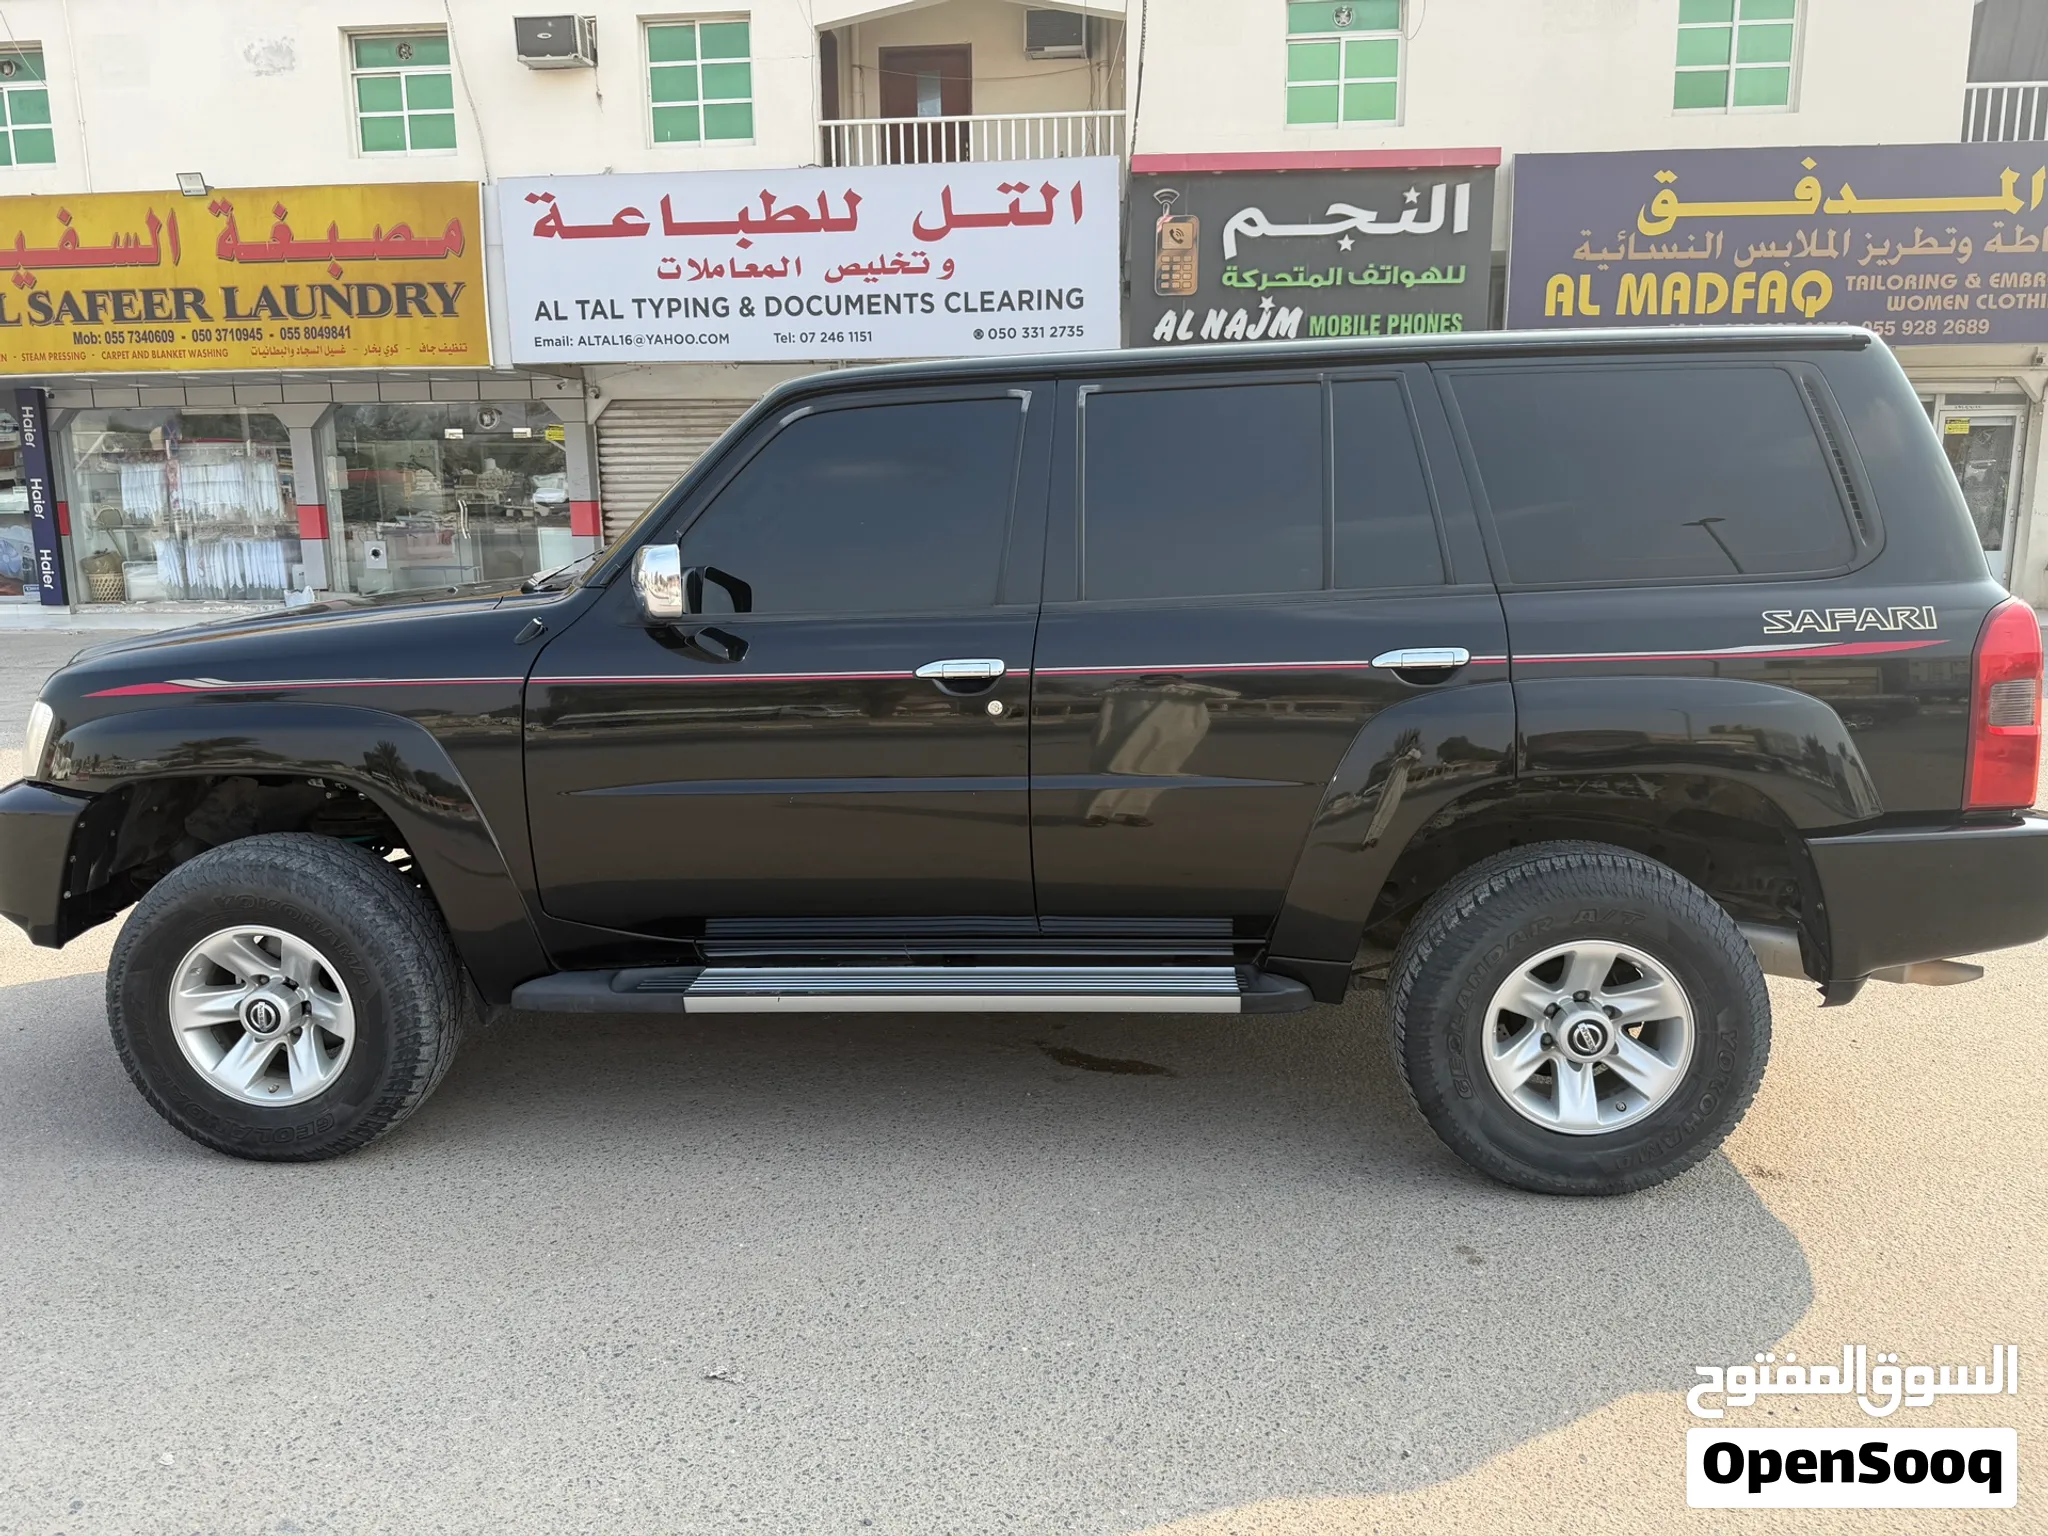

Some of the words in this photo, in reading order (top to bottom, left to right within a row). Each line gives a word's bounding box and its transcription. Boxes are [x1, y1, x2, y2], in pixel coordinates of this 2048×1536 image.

[1637, 156, 2046, 236] المدفق
[525, 187, 863, 250] للطباعة
[912, 180, 1084, 242] التل
[1222, 182, 1471, 260] النجم
[0, 207, 181, 289] السفي
[208, 198, 465, 279] مصبغة
[1573, 229, 1724, 271] النسائية
[1734, 227, 1851, 268] الملابس
[1857, 227, 1973, 267] وتطريز
[1984, 220, 2048, 253] اطة
[657, 256, 801, 281] المعاملات
[1221, 264, 1342, 291] المتحركة
[1348, 263, 1466, 285] للهواتف
[1845, 273, 1958, 292] TAILORING
[1965, 273, 1981, 288] &
[1989, 272, 2048, 288] EMBR
[28, 287, 214, 326] SAFEER
[221, 282, 466, 321] LAUNDRY
[535, 299, 569, 321] AL
[576, 298, 624, 320] TAL
[632, 296, 730, 319] TYPING
[739, 295, 756, 317] &
[765, 291, 935, 317] DOCUMENTS
[944, 287, 1085, 313] CLEARING
[1544, 274, 1600, 317] AL
[1615, 269, 1833, 319] MADFAQ
[1887, 294, 1968, 311] WOMEN
[1976, 293, 2048, 309] CLOTHI
[988, 327, 1017, 340] 050
[1021, 326, 1045, 339] 331
[1050, 325, 1084, 338] 2735
[1153, 309, 1194, 342] AL
[1200, 297, 1304, 341] NAJM
[1309, 314, 1381, 337] MOBILE
[1387, 313, 1463, 334] PHONES
[1862, 321, 1895, 336] 055
[1902, 320, 1937, 336] 928
[1943, 319, 1990, 335] 2689
[73, 331, 101, 345] Mob:
[105, 331, 125, 344] 055
[128, 330, 174, 343] 7340609
[192, 329, 212, 342] 050
[215, 328, 263, 342] 3710945
[280, 327, 300, 340] 055
[304, 326, 351, 339] 8049841
[419, 343, 437, 353] جاف
[438, 343, 468, 353] تنظيف
[534, 335, 574, 348] Email:
[577, 333, 730, 347] ALTAL16@YAHOO.COM
[774, 332, 795, 344] Tel:
[799, 332, 816, 344] 07
[820, 331, 845, 343] 246
[848, 331, 873, 343] 1151
[21, 352, 47, 362] STEAM
[48, 351, 87, 361] PRESSING
[101, 350, 130, 360] CARPET
[132, 350, 150, 359] AND
[151, 349, 186, 359] BLANKET
[188, 348, 228, 359] WASHING
[296, 345, 323, 355] السجاد
[325, 344, 347, 357] غسيل
[363, 344, 382, 356] بخار
[21, 406, 37, 448] Haier
[30, 478, 45, 520] Haier
[39, 549, 55, 589] Haier
[1763, 606, 1938, 634] SAFARI
[1571, 908, 1648, 926] A/T
